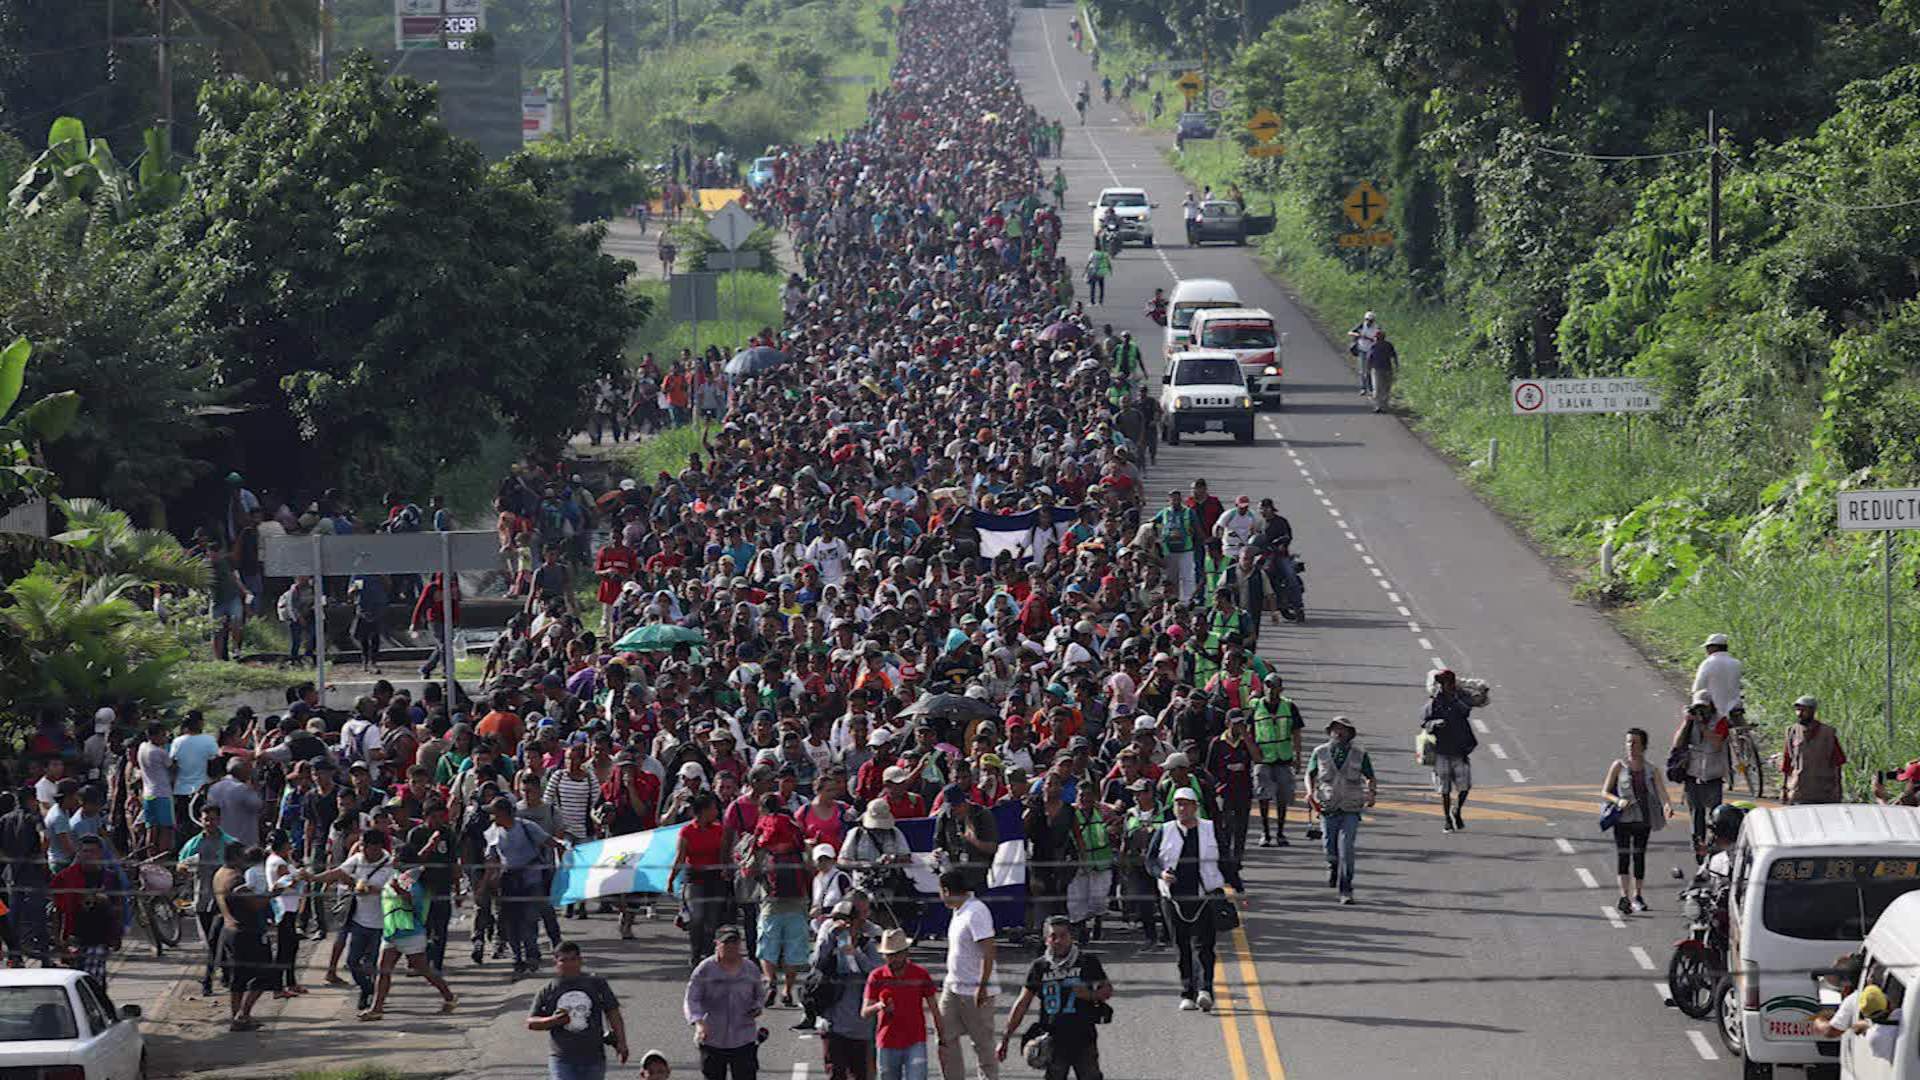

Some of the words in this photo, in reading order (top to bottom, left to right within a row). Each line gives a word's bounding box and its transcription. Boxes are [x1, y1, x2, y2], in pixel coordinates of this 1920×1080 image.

[1591, 383, 1605, 393] EL
[1559, 398, 1593, 408] SALVA
[1603, 397, 1616, 408] TU
[1625, 397, 1651, 408] VIDA
[1849, 498, 1920, 520] REDUCT
